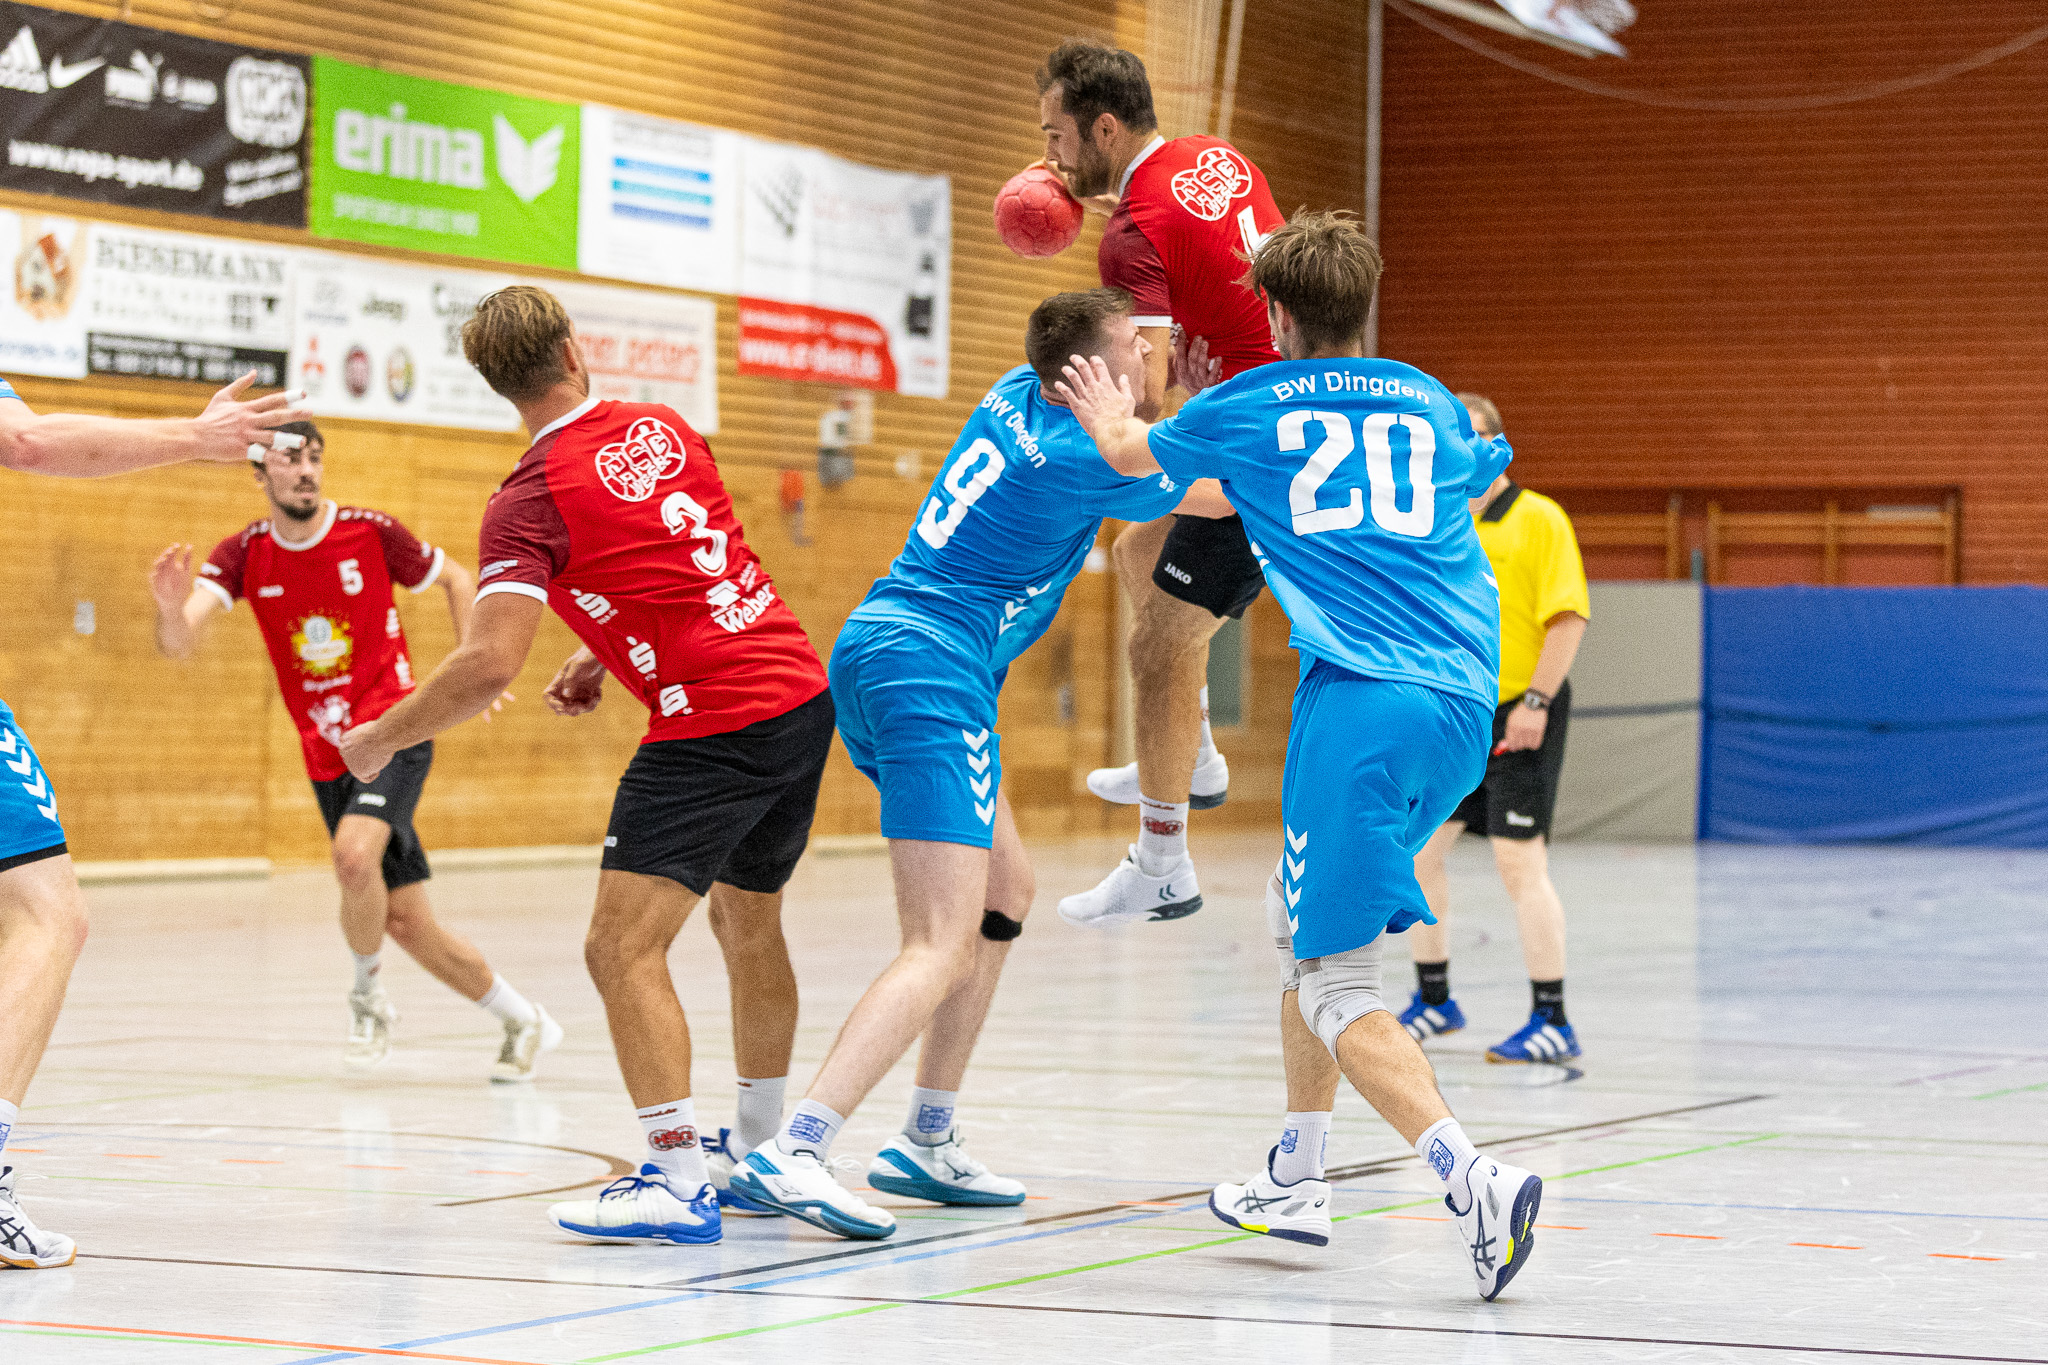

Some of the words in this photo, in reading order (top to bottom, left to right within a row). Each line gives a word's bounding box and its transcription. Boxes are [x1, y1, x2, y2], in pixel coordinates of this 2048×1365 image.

[334, 102, 487, 190] erima
[1271, 374, 1316, 402] BW
[1323, 370, 1430, 405] Dingden
[981, 391, 1010, 418] BW
[1004, 412, 1048, 469] Dingden
[917, 437, 1006, 550] 9
[1276, 409, 1436, 538] 20
[660, 491, 728, 577] 3
[338, 558, 364, 595] 5
[1163, 562, 1193, 585] JAKO
[713, 583, 776, 633] Weber
[653, 1130, 694, 1145] HSG
